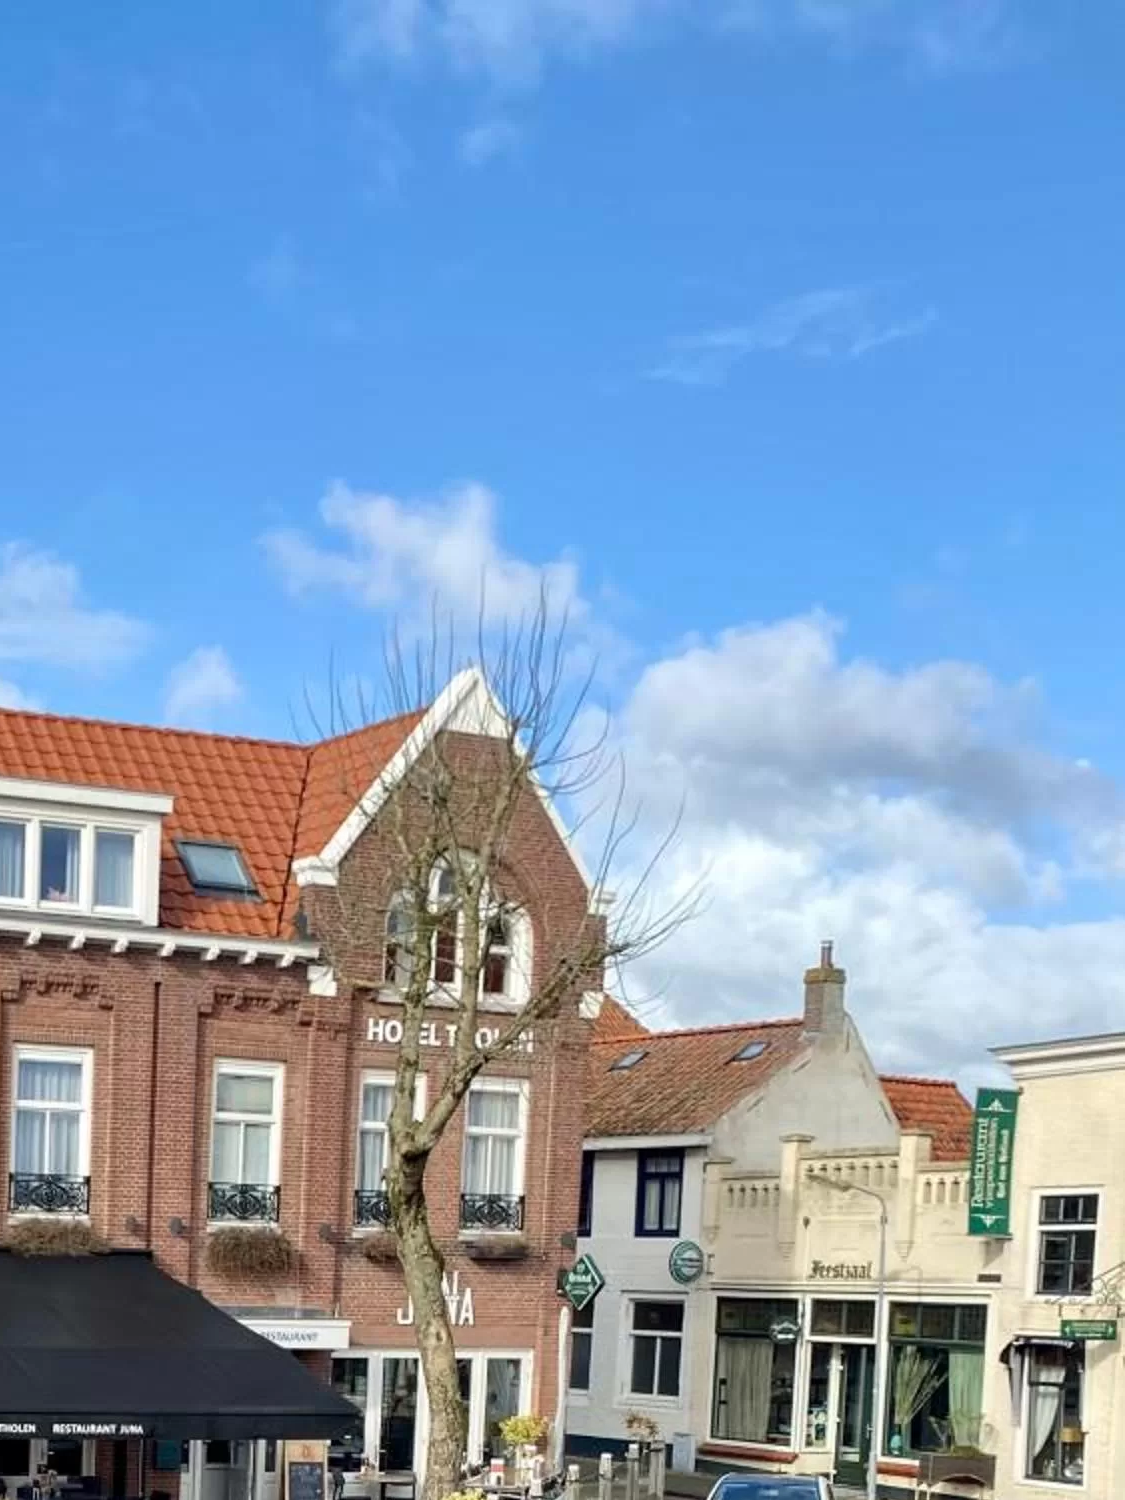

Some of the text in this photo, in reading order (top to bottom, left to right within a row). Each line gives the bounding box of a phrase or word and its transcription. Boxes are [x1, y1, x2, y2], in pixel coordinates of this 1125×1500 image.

[367, 1017, 442, 1047] HOEL
[971, 1118, 989, 1208] Restaurant
[52, 1423, 117, 1435] RESTAURANT
